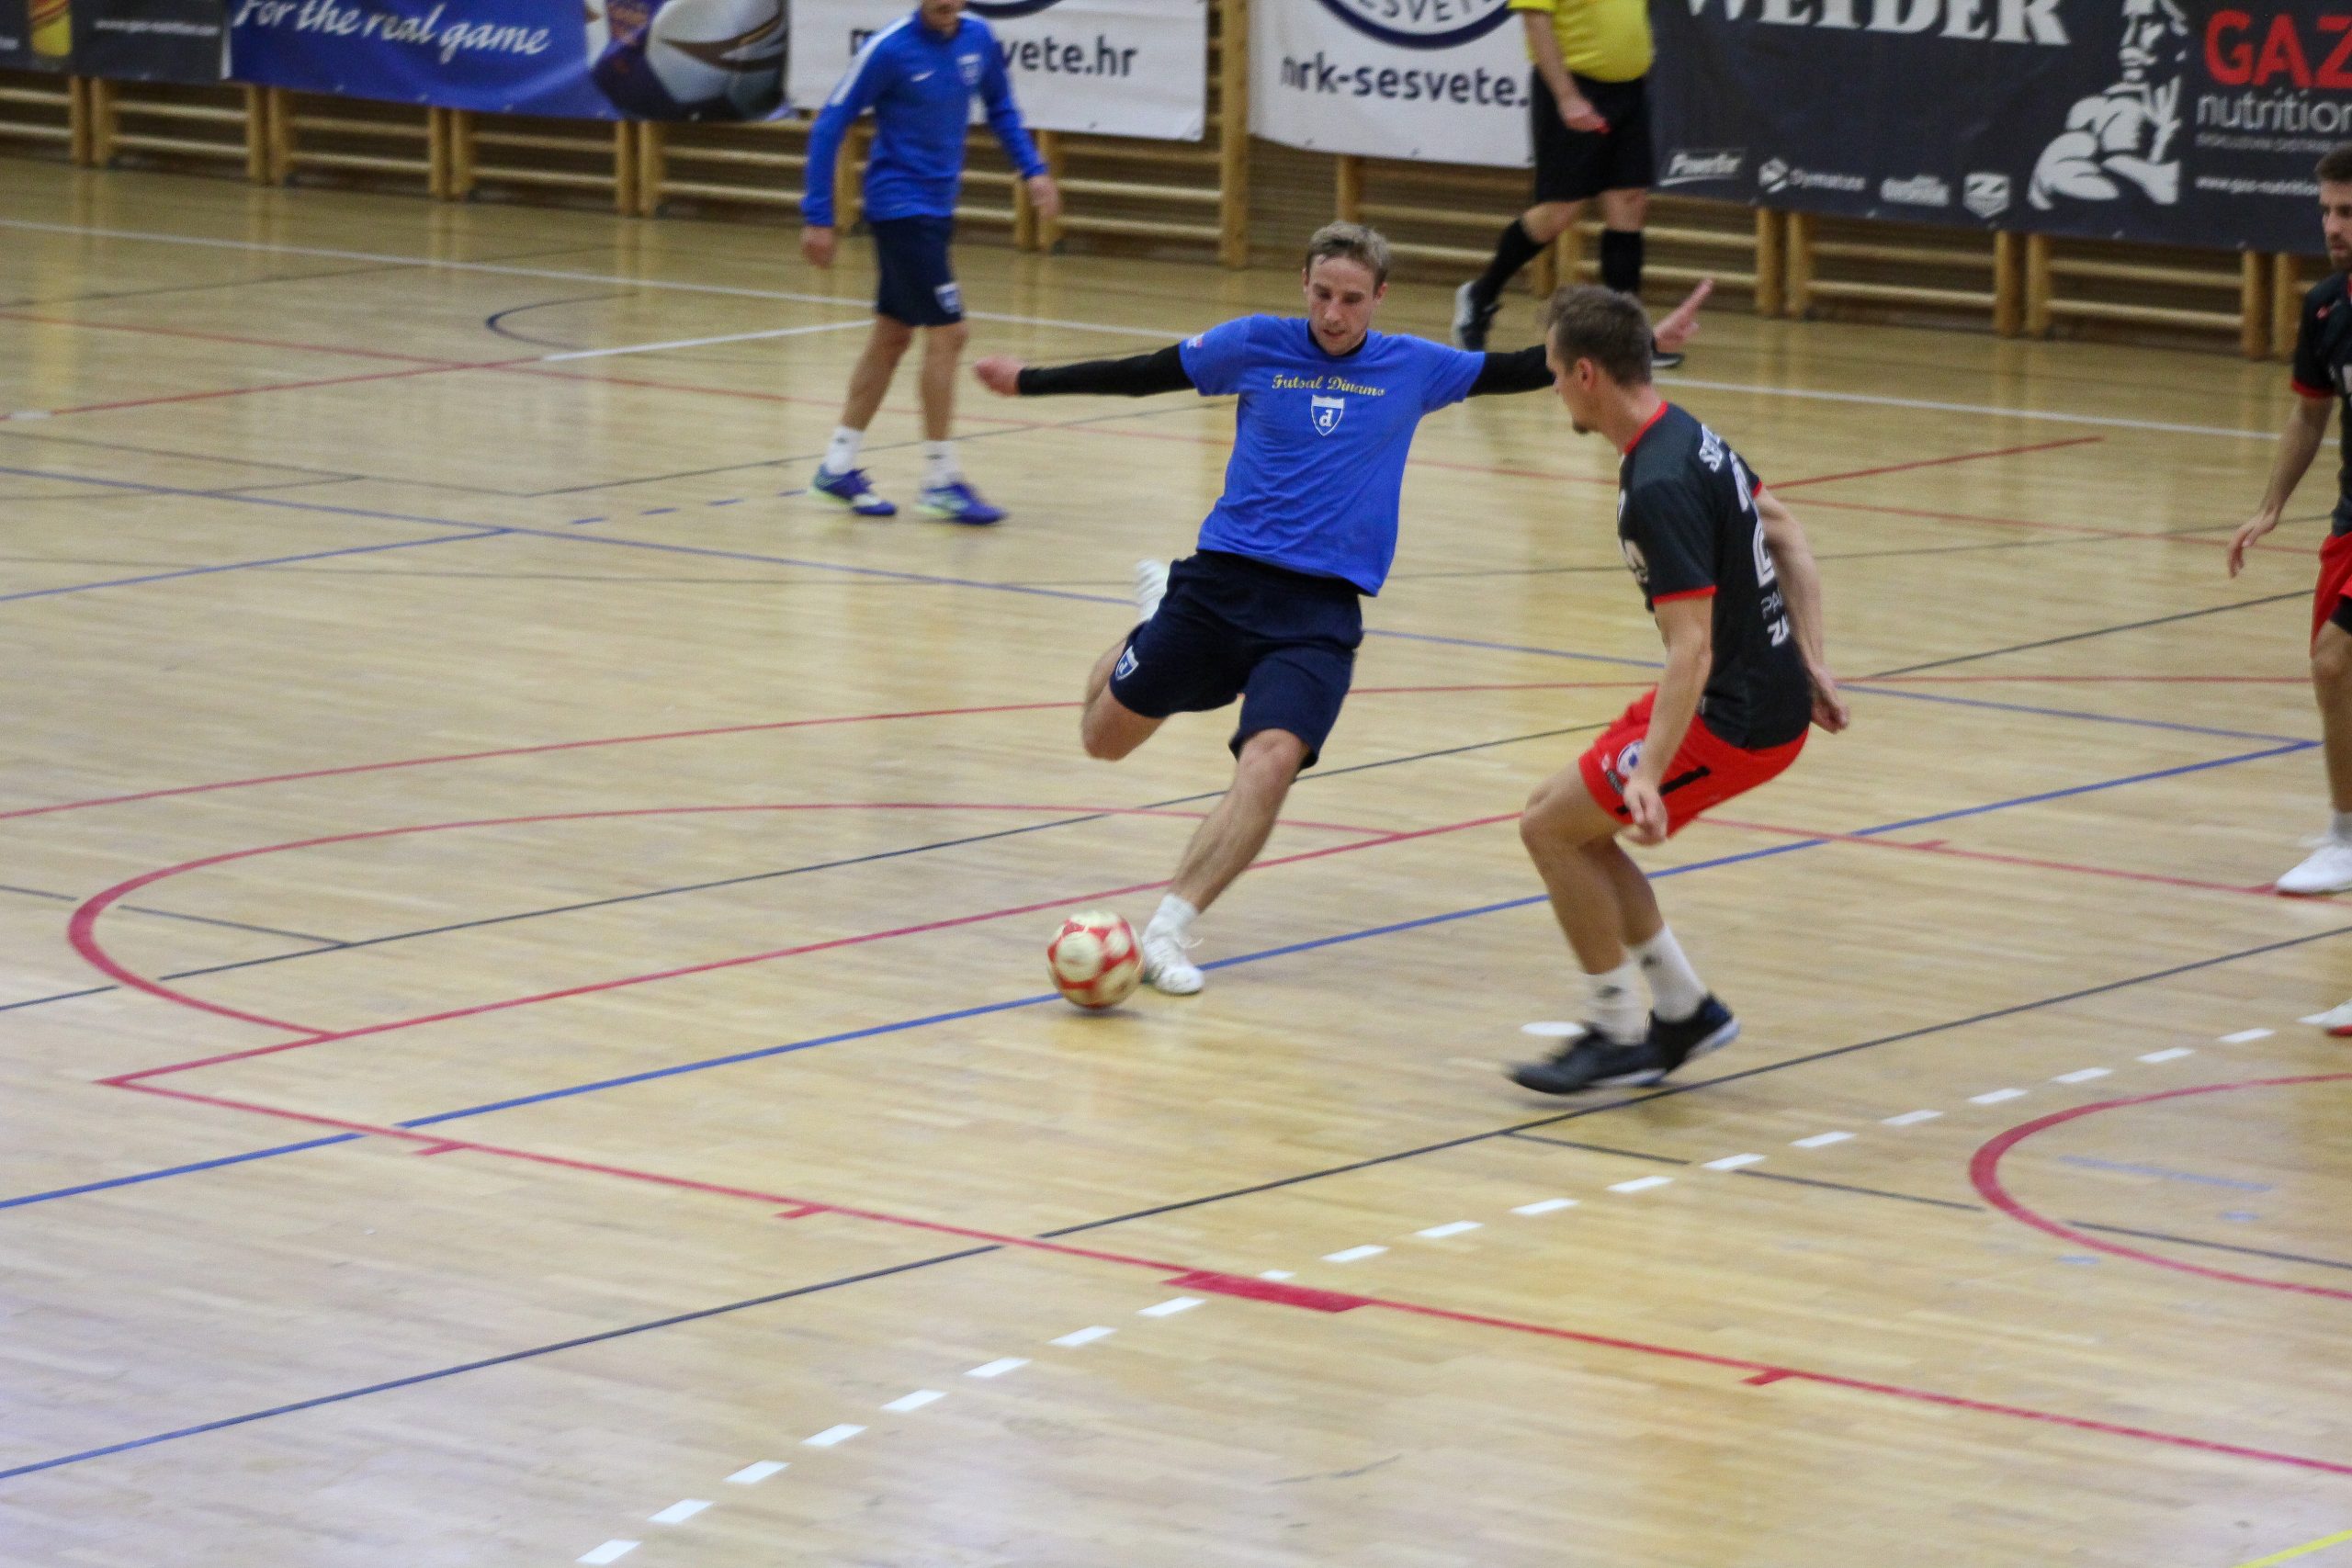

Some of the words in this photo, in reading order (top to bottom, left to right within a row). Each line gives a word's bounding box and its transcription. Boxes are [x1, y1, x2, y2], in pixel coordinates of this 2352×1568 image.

[361, 4, 438, 45] real
[438, 21, 549, 64] game
[1281, 51, 1530, 107] nrk-sesvete.
[1272, 373, 1323, 390] Futsal
[1326, 375, 1386, 397] Dinamo
[1318, 409, 1334, 428] d
